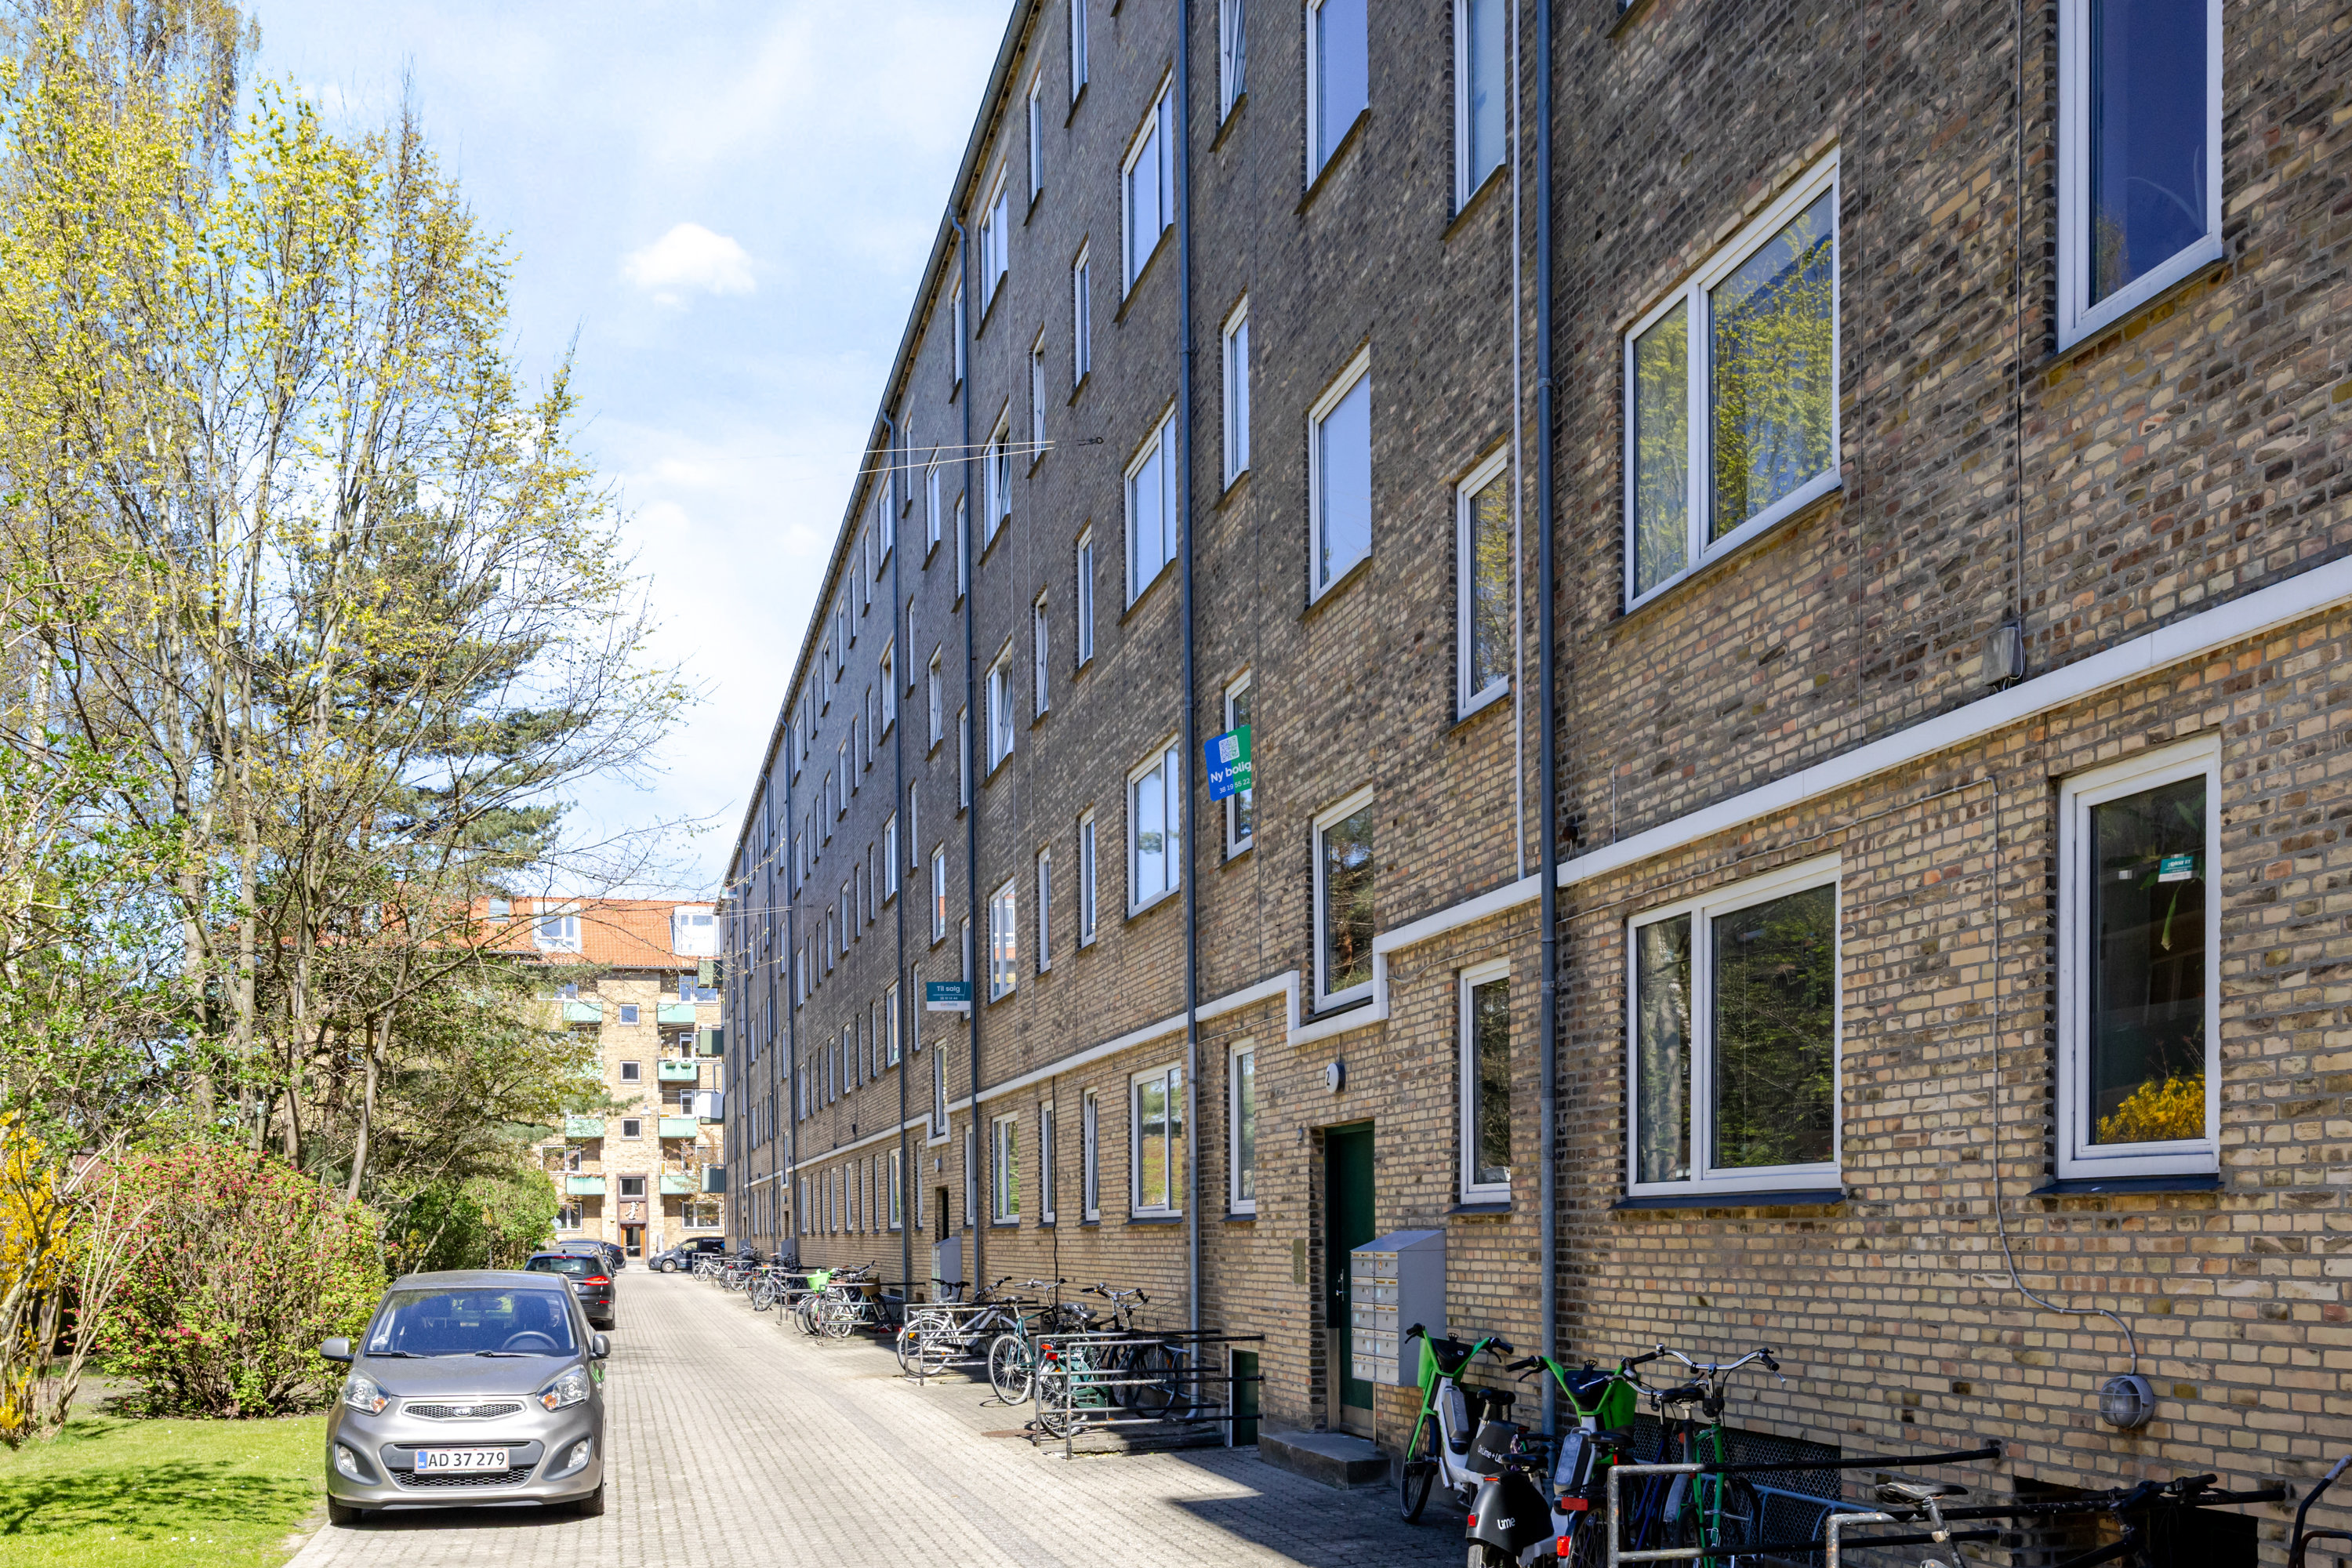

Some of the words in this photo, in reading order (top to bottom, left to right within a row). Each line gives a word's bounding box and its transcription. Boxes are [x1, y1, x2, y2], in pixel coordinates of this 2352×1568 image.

[1210, 771, 1223, 783] Ny
[1225, 761, 1252, 777] bolig
[946, 985, 960, 993] salg
[428, 1454, 449, 1467] AD
[453, 1453, 472, 1466] 37
[477, 1452, 505, 1466] 279
[1497, 1517, 1515, 1530] Lime
